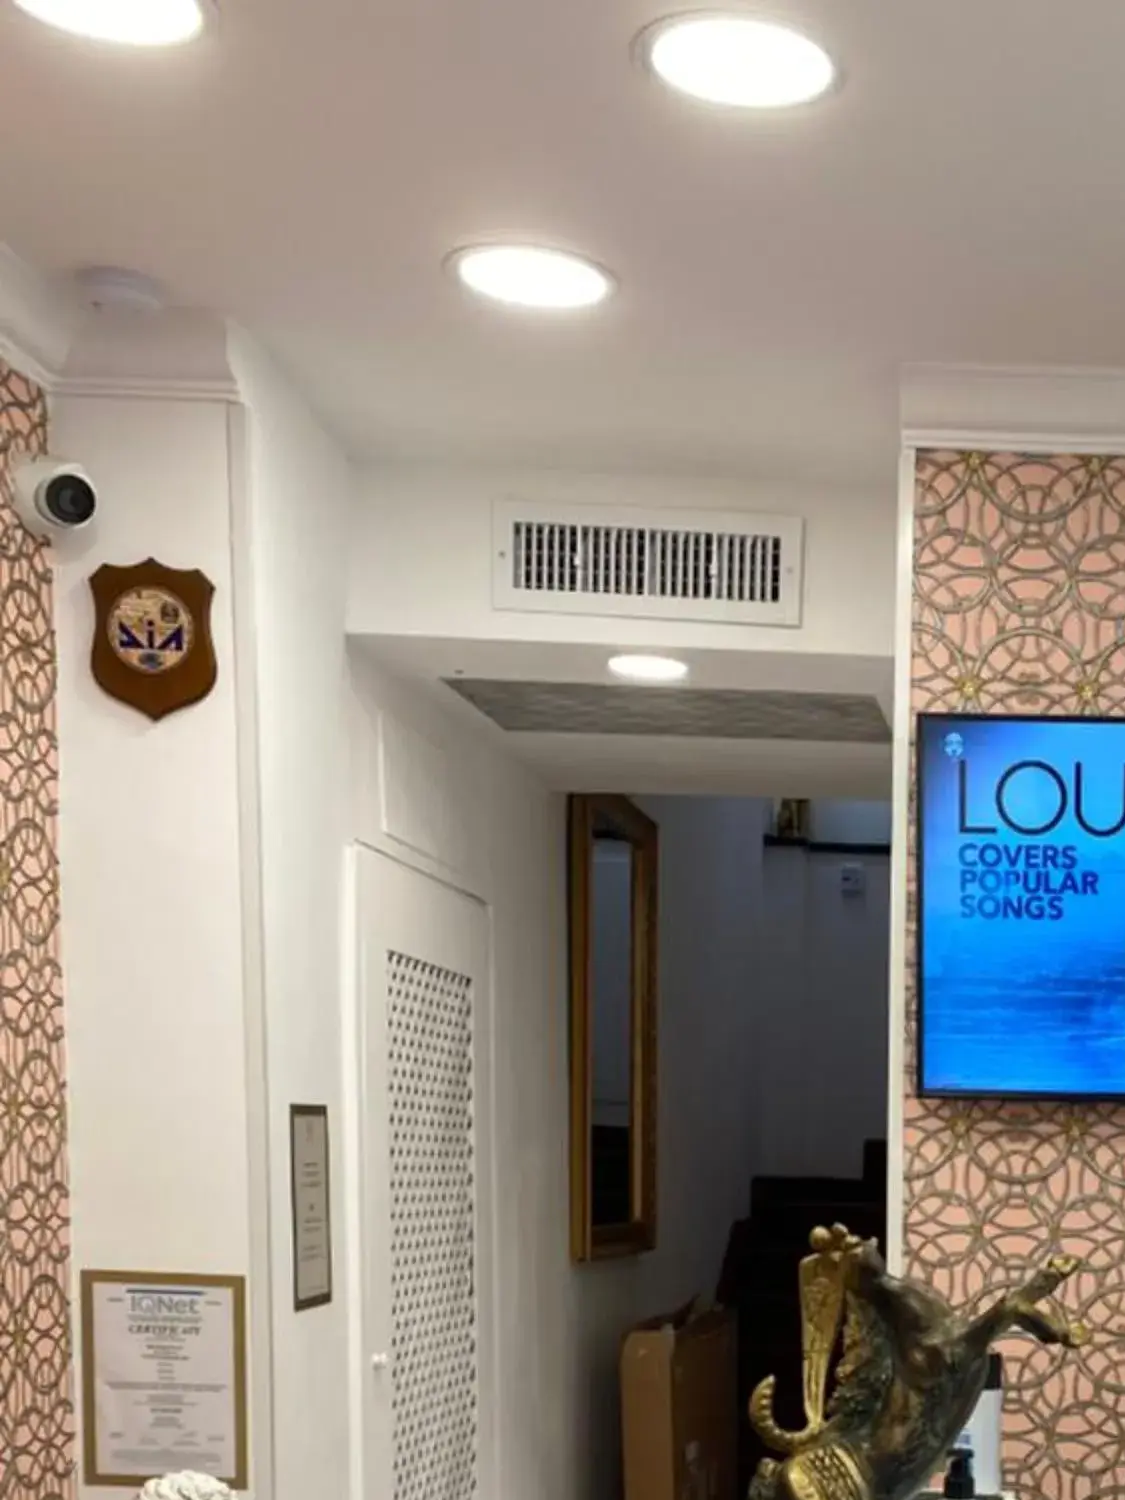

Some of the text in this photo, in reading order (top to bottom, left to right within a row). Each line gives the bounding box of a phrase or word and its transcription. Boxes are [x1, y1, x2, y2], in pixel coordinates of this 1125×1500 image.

[957, 843, 1079, 870] COVERS
[958, 869, 1099, 896] POPULAR
[959, 895, 1065, 921] SONGS
